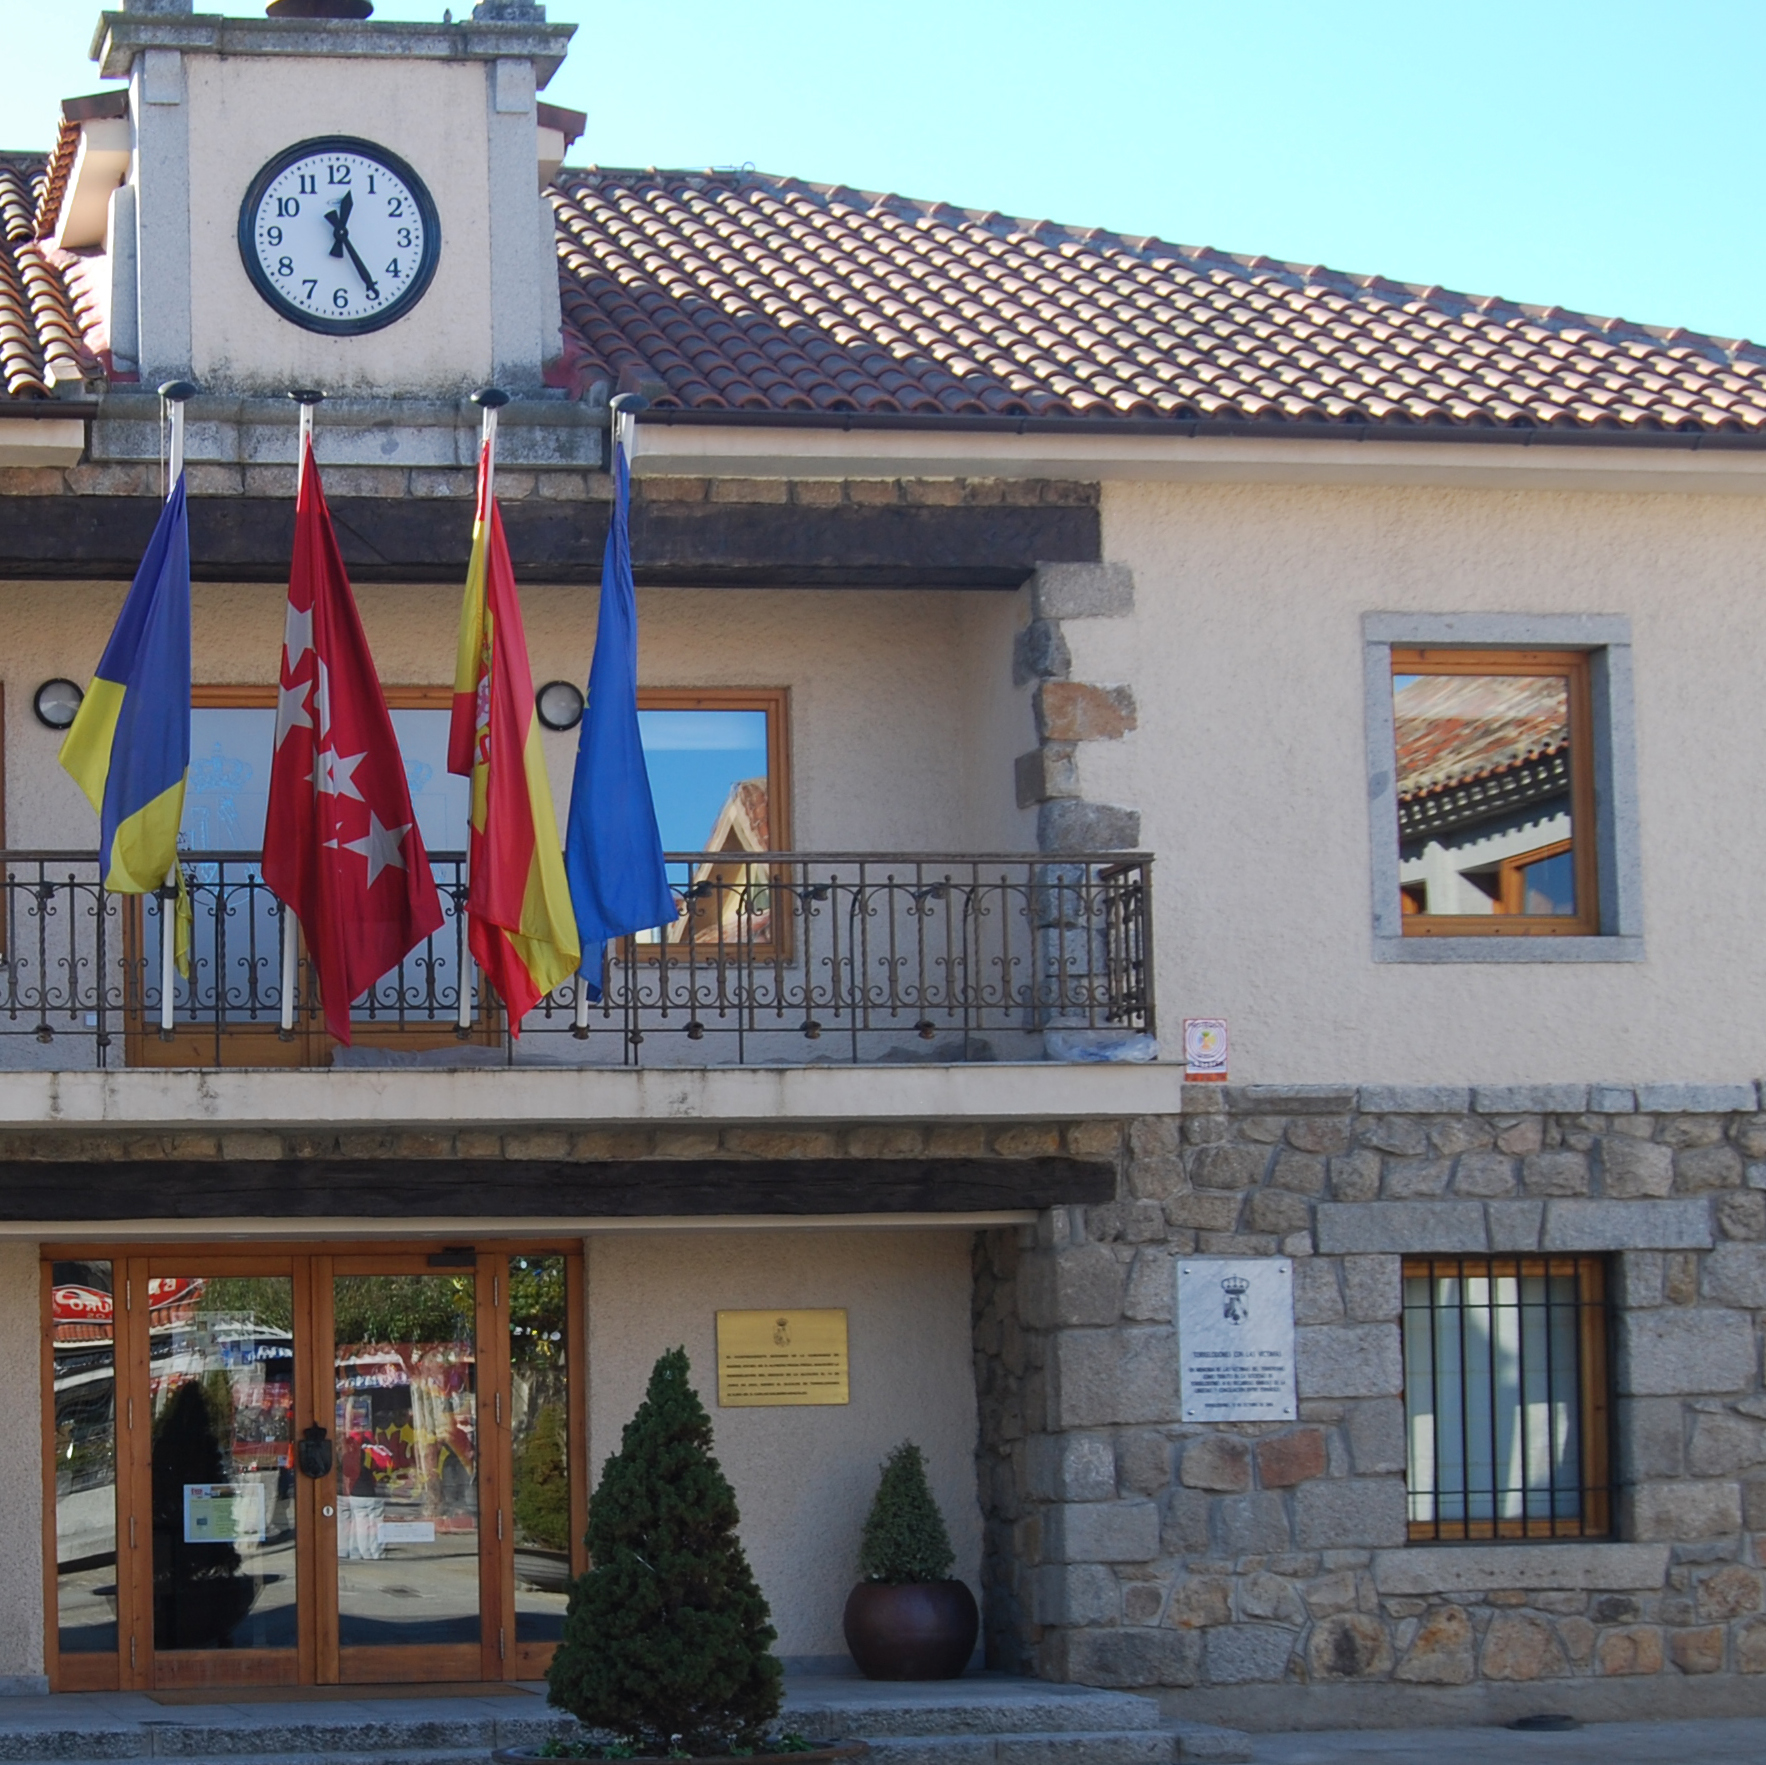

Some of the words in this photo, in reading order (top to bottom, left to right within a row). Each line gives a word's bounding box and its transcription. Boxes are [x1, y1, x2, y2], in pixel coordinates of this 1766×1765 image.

[299, 174, 317, 194] 11
[328, 165, 351, 184] 12
[368, 174, 376, 194] 1
[276, 197, 299, 217] 10
[388, 197, 402, 217] 2
[267, 226, 282, 246] 9
[397, 228, 412, 247] 3
[277, 256, 294, 276] 8
[385, 258, 401, 278] 4
[302, 279, 318, 299] 7
[333, 288, 348, 308] 6
